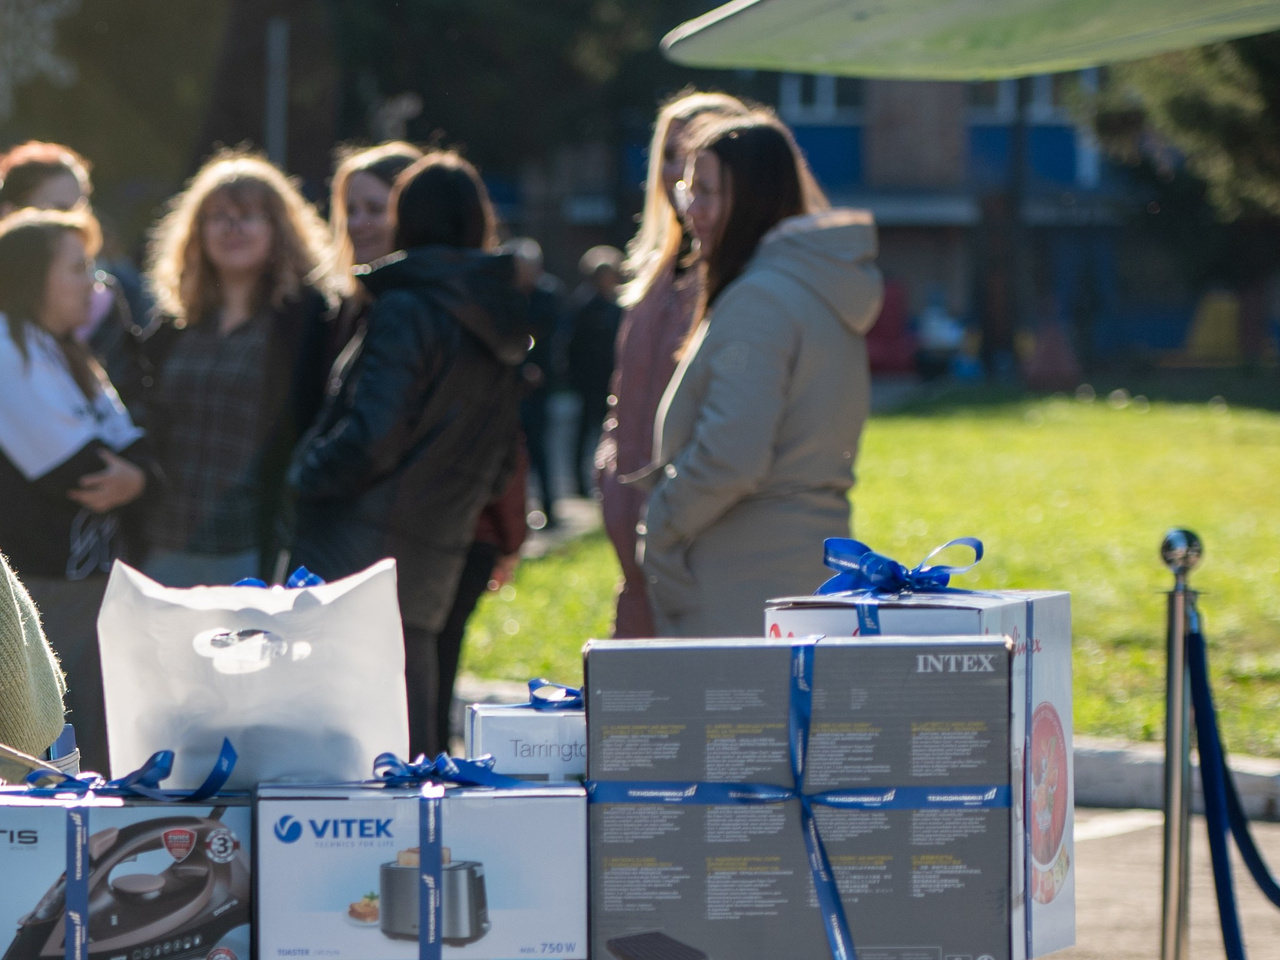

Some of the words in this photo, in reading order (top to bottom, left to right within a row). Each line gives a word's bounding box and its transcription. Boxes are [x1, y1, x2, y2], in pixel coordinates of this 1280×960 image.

[916, 654, 996, 673] INTEX
[308, 818, 394, 839] VITEK
[217, 837, 228, 854] 3
[540, 943, 564, 953] 750
[565, 942, 577, 953] W
